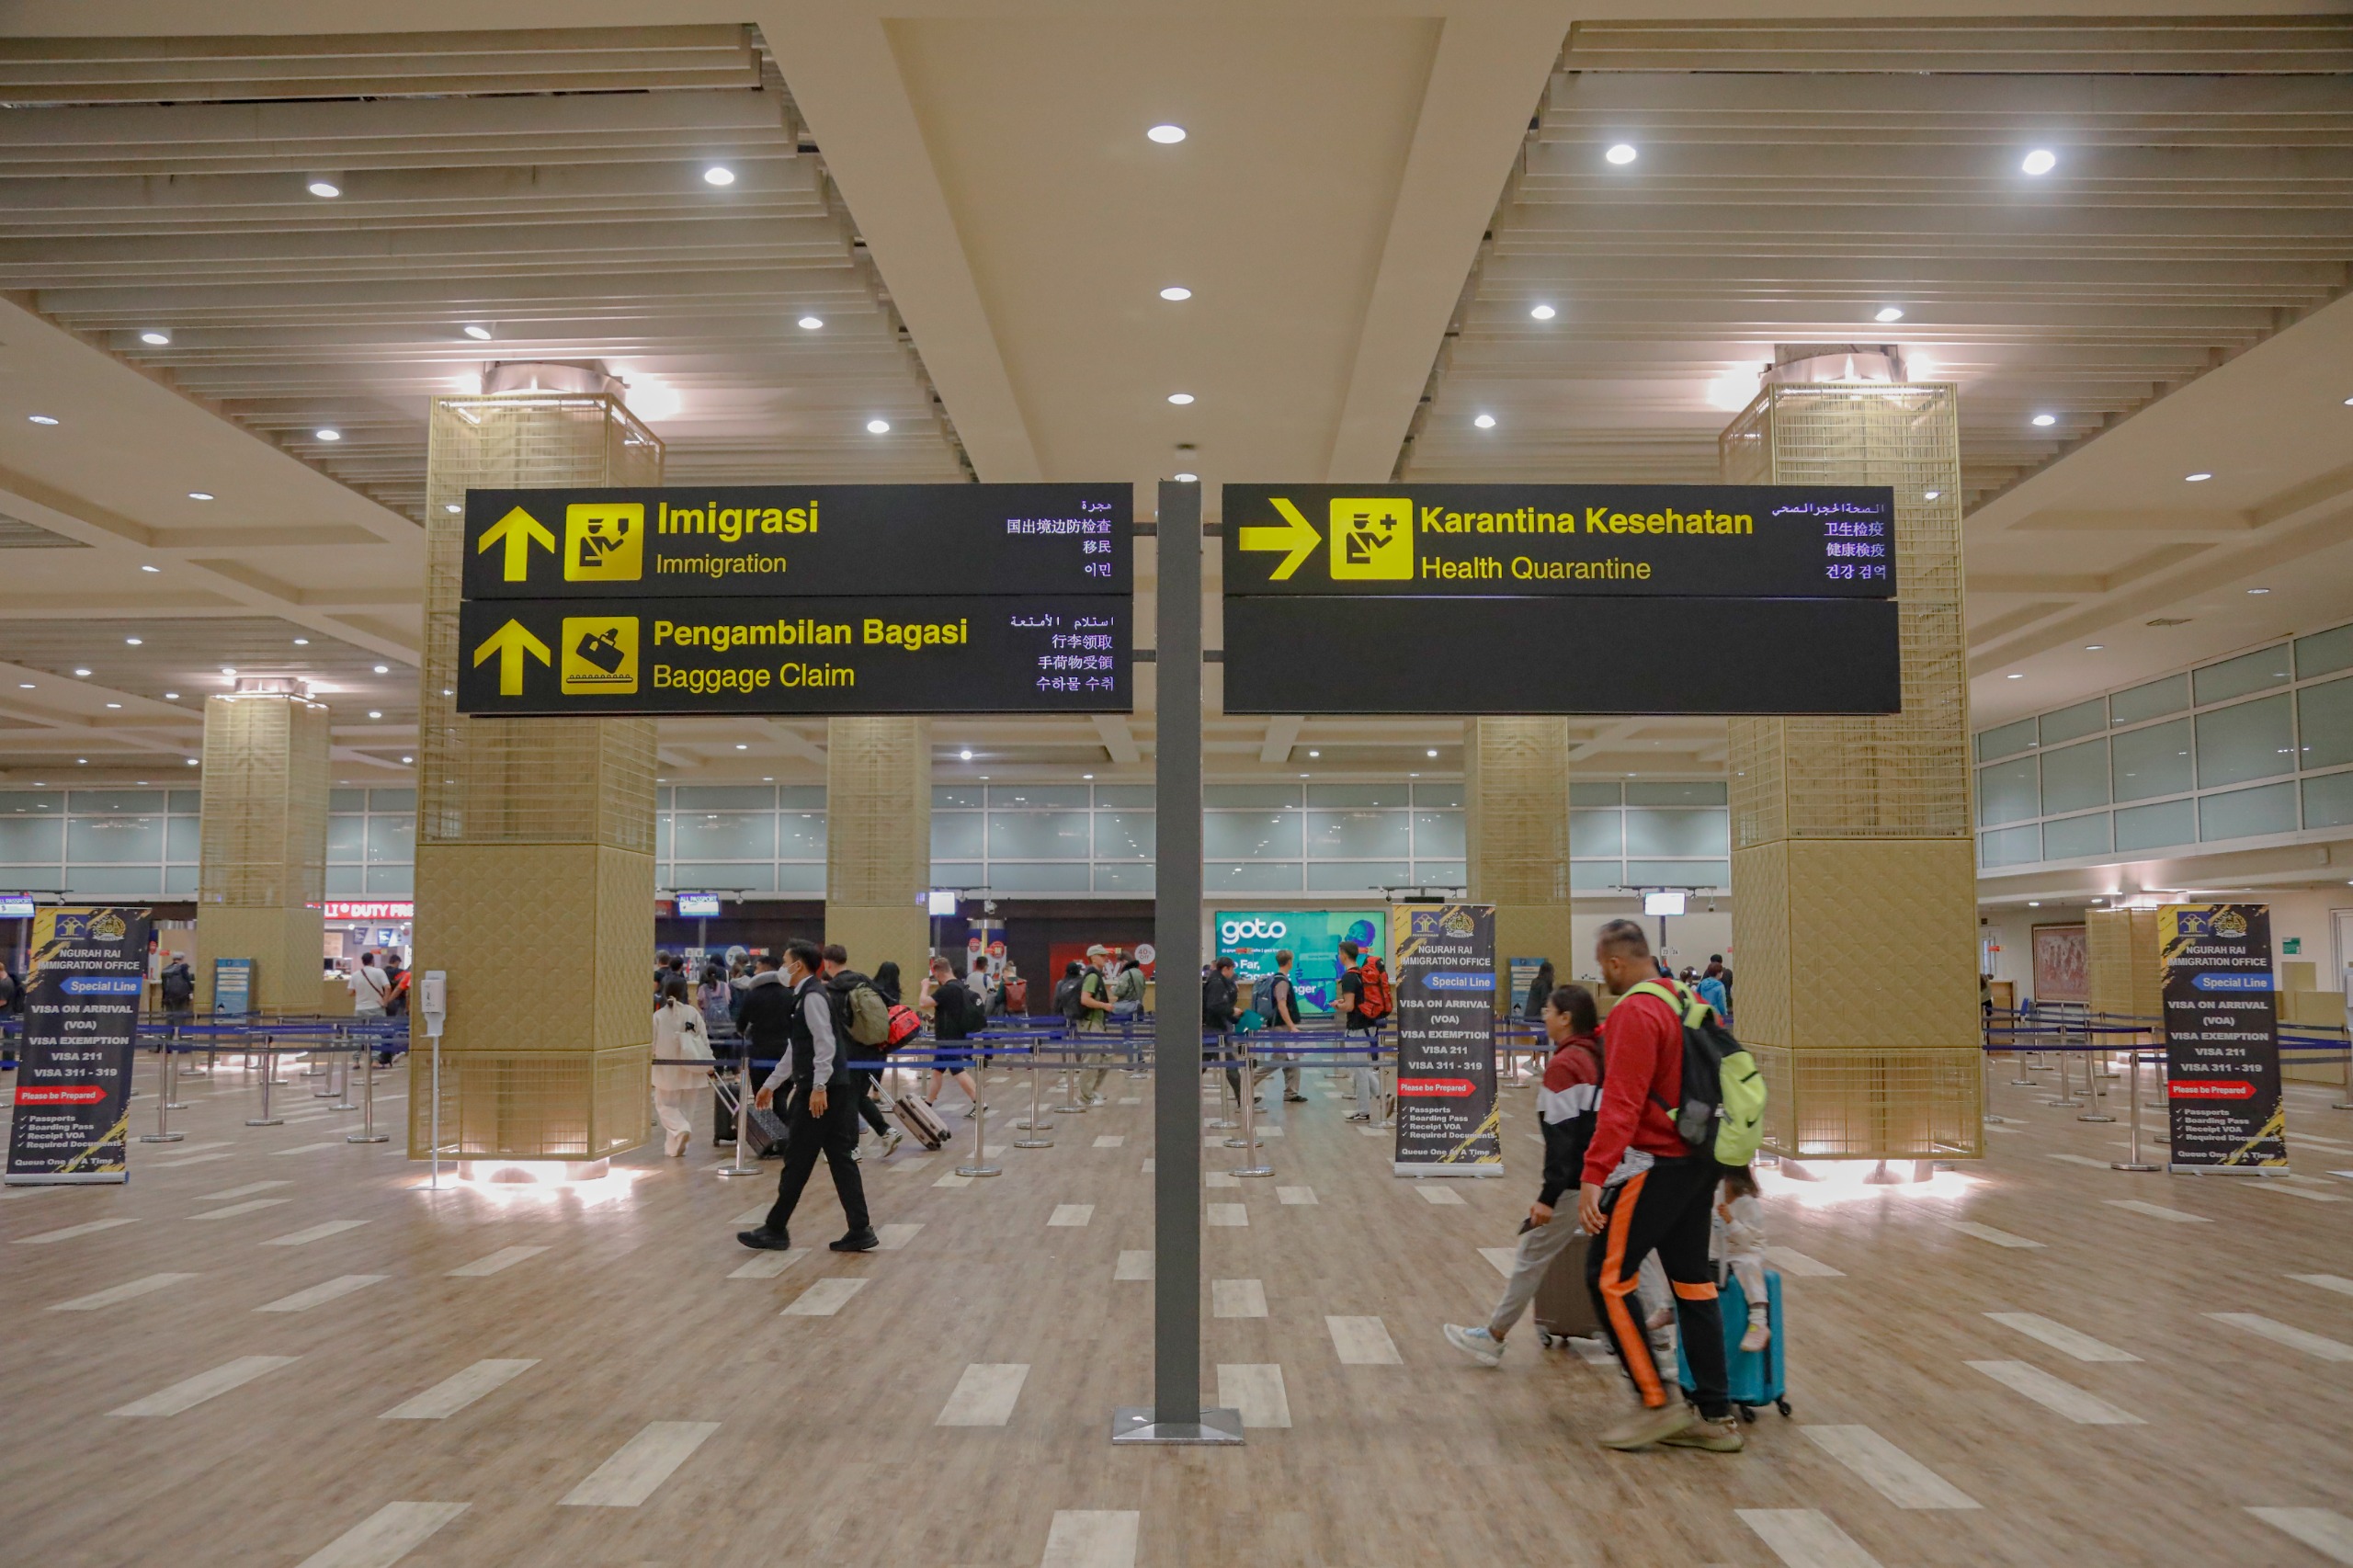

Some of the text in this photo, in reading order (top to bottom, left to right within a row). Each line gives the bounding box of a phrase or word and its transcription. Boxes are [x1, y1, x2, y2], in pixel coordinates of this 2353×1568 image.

[1082, 500, 1112, 513] هجرة
[658, 500, 818, 542] Imigrasi
[1421, 506, 1754, 535] Karantina Kesehatan
[1006, 518, 1111, 534] 国出境边防检查
[1824, 521, 1884, 538] 卫生检疫
[1083, 540, 1111, 554] 移民
[656, 554, 787, 579] Immigration
[1085, 562, 1111, 577] 이민
[1421, 555, 1652, 580] Health Quarantine
[1825, 563, 1855, 580] 건강
[1074, 616, 1114, 631] استلام
[654, 618, 967, 653] Pengambilan Bagasi
[1051, 633, 1113, 651] 行李领取
[1038, 654, 1113, 670] 手荷物受領
[654, 662, 855, 694] Baggage Claim
[1036, 676, 1114, 692] 수하물 수취
[350, 903, 388, 917] DUTY
[390, 903, 414, 917] FRE
[1222, 918, 1287, 945] goto
[60, 949, 120, 958] NGURAH RAI
[1418, 946, 1456, 954] NGURAH
[2187, 946, 2245, 954] NGURAH RAI
[38, 961, 102, 970] IMMIGRATION
[1240, 960, 1260, 971] Far,
[1401, 957, 1491, 966] IMMIGRATION OFFICE
[2167, 958, 2267, 966] IMMIGRATION OFFICE
[1432, 977, 1490, 987] Special Line
[2203, 978, 2268, 988] Special Line
[71, 982, 136, 993] Special Line
[1445, 1000, 1490, 1008] ARRIVAL
[2167, 1001, 2196, 1009] VISA
[2199, 1001, 2215, 1009] ON
[64, 1021, 97, 1030] (VOA)
[1431, 1016, 1460, 1025] (VOA)
[2203, 1017, 2234, 1026] (VOA)
[1401, 1030, 1426, 1039] VISA
[2171, 1032, 2199, 1040] VISA
[29, 1037, 129, 1045] VISA EXEMPTION
[51, 1052, 103, 1061] VISA 211
[1408, 1062, 1434, 1070] VISA
[1437, 1062, 1454, 1070] 311
[2180, 1063, 2210, 1072] VISA
[2242, 1064, 2263, 1073] 319
[34, 1069, 63, 1077] VISA
[64, 1069, 85, 1077] 311
[2211, 1086, 2245, 1095] Prepared
[61, 1092, 96, 1100] Prepared
[1410, 1131, 1447, 1140] Required
[2186, 1134, 2226, 1142] Required
